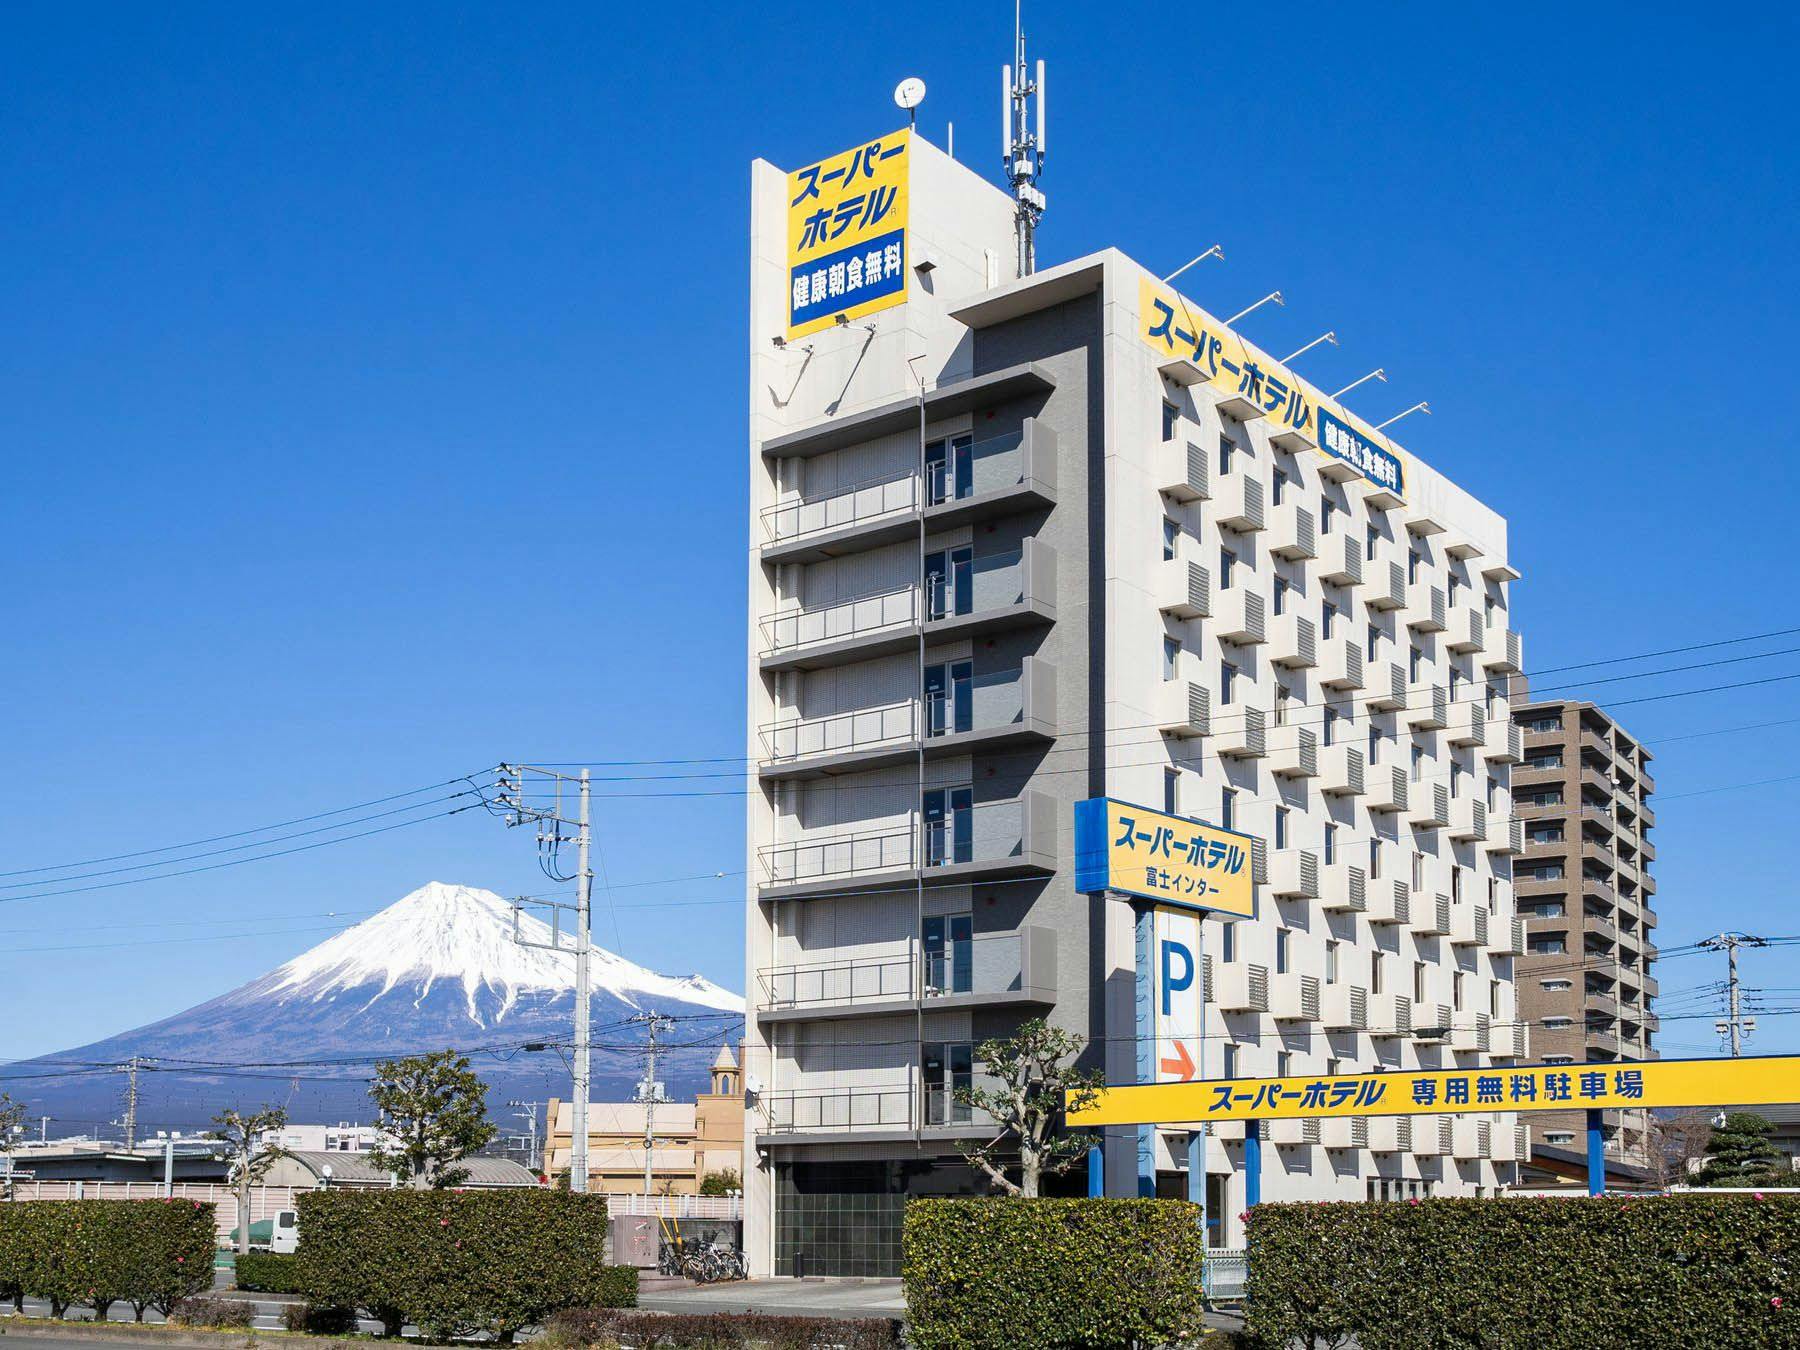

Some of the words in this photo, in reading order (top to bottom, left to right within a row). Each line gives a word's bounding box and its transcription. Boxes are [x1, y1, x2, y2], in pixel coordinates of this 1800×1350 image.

[790, 142, 906, 208] スーパー
[797, 185, 898, 252] ホテル
[792, 242, 902, 310] 健康朝食無料
[1148, 297, 1310, 430] スーパーホテル
[1115, 816, 1245, 875] スーパーホテル
[1145, 866, 1220, 896] 富士インター
[1161, 939, 1195, 1016] P
[1208, 1079, 1387, 1112] スーパーホテル
[1411, 1070, 1644, 1106] 専用無料駐車場
